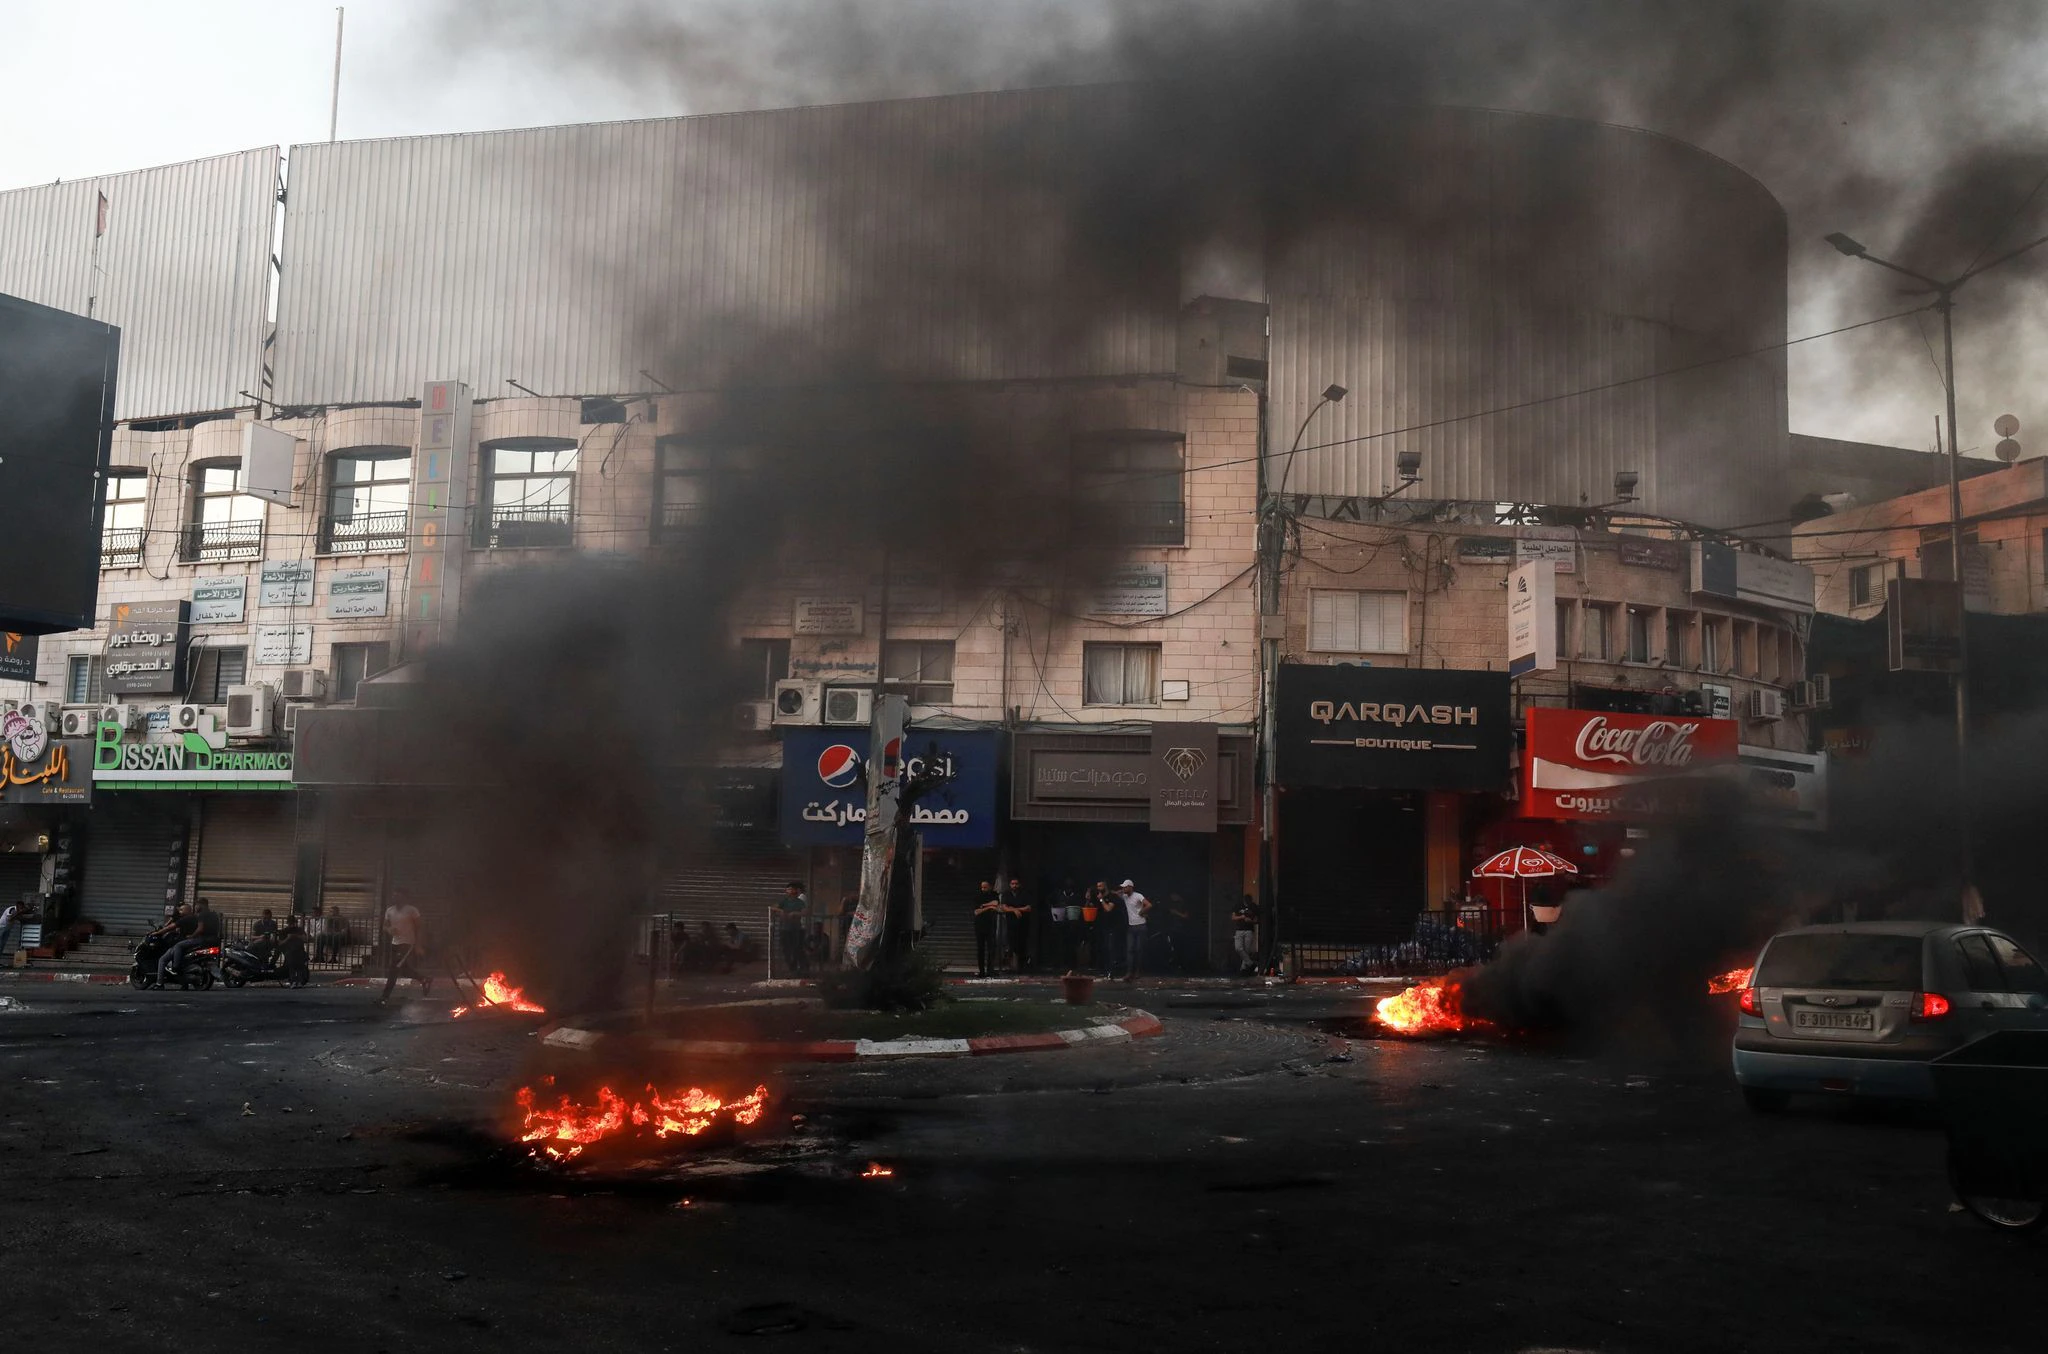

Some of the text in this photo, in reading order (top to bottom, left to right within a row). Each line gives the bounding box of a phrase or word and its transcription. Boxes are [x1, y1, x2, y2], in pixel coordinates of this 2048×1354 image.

[344, 570, 375, 579] الدكتور
[108, 633, 130, 647] جرار
[130, 630, 161, 646] روضة
[1310, 700, 1478, 727] QARQASH
[94, 721, 185, 770] BISSAN
[1355, 737, 1433, 751] BOUTIQUE
[1575, 715, 1700, 768] Coca-Cola
[1159, 788, 1209, 799] STELLA
[1555, 793, 1611, 815] بيروت
